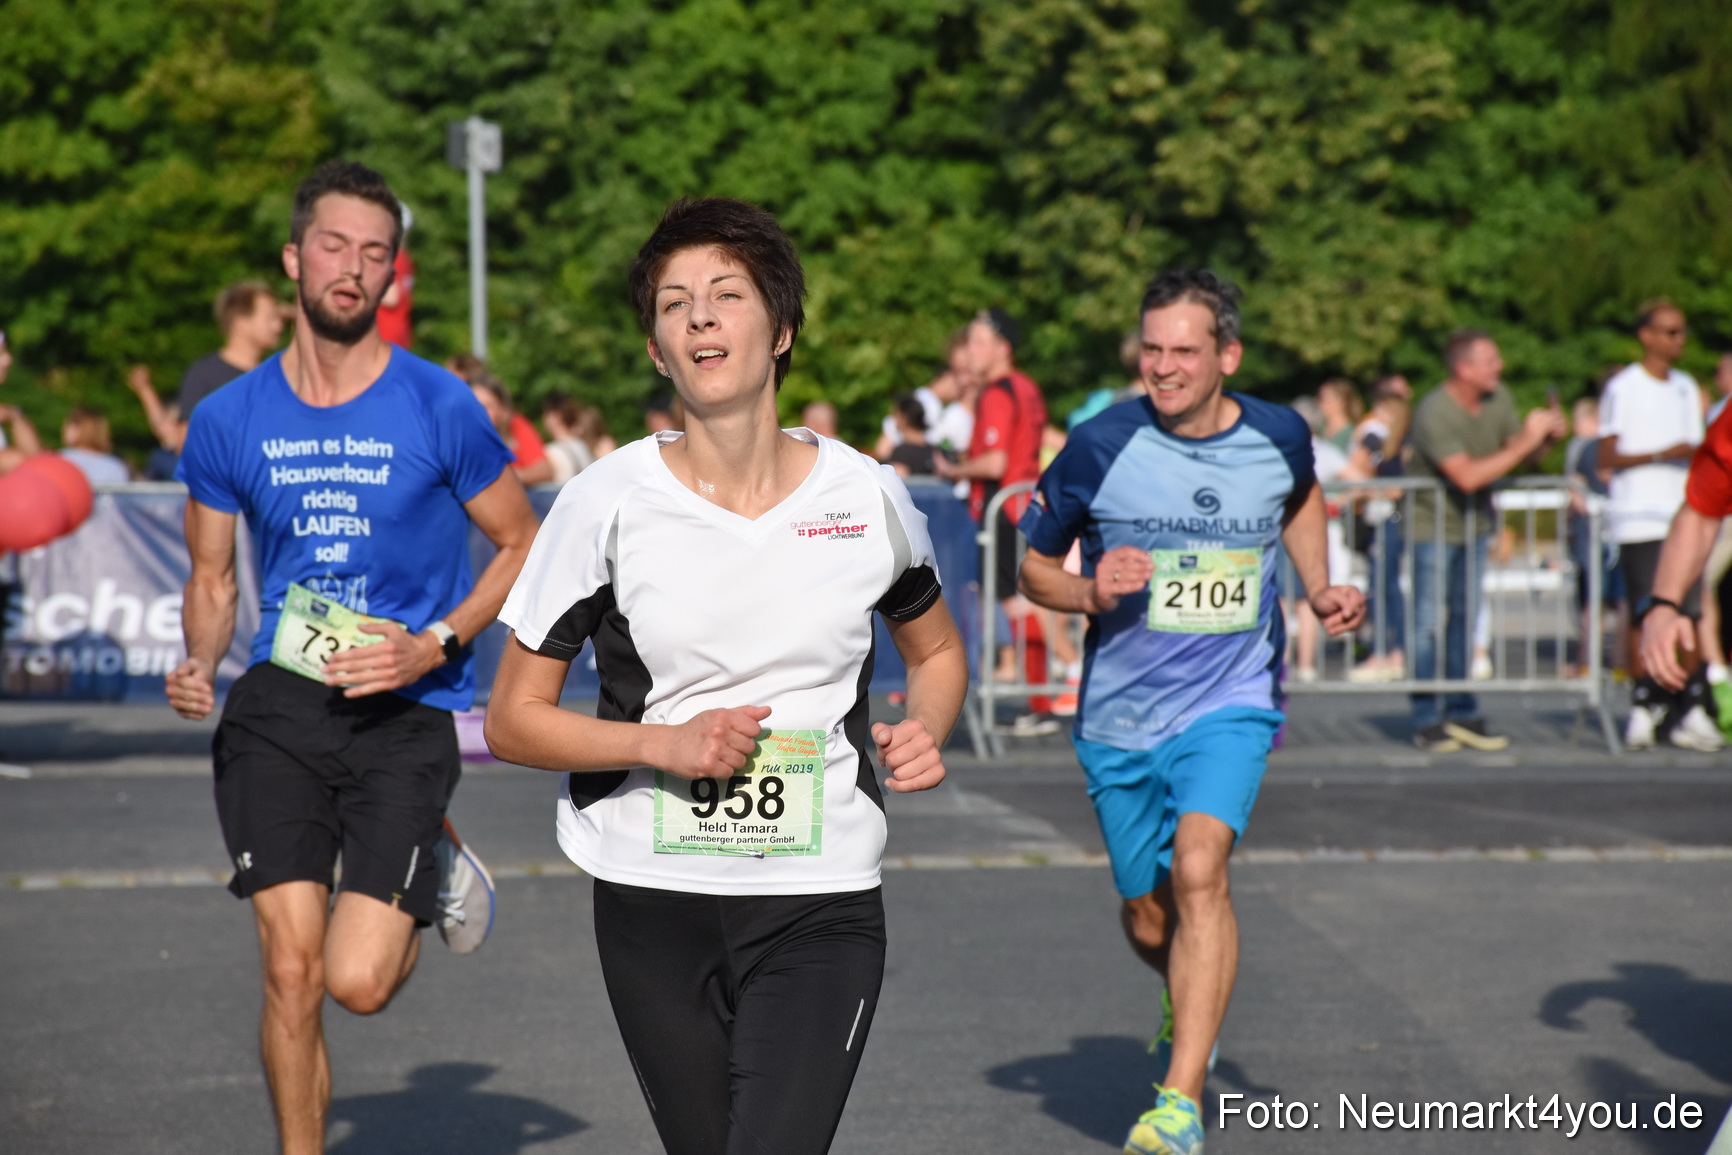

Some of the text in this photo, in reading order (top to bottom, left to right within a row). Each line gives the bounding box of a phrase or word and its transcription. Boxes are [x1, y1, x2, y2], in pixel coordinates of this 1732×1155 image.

[262, 434, 393, 460] Wenn es beim
[271, 462, 390, 486] Hausverkauf
[302, 488, 357, 512] richtig
[292, 515, 371, 537] LAUFEN
[790, 519, 843, 529] guttenberger
[825, 512, 851, 521] TEAM
[807, 524, 868, 537] partner
[314, 543, 349, 563] soll!
[1165, 580, 1247, 609] 2104
[302, 624, 357, 665] 73
[760, 763, 814, 774] run 2019
[690, 776, 785, 820] 958
[698, 821, 778, 834] Held Tamara
[679, 834, 795, 845] guttenberger partner GmbH
